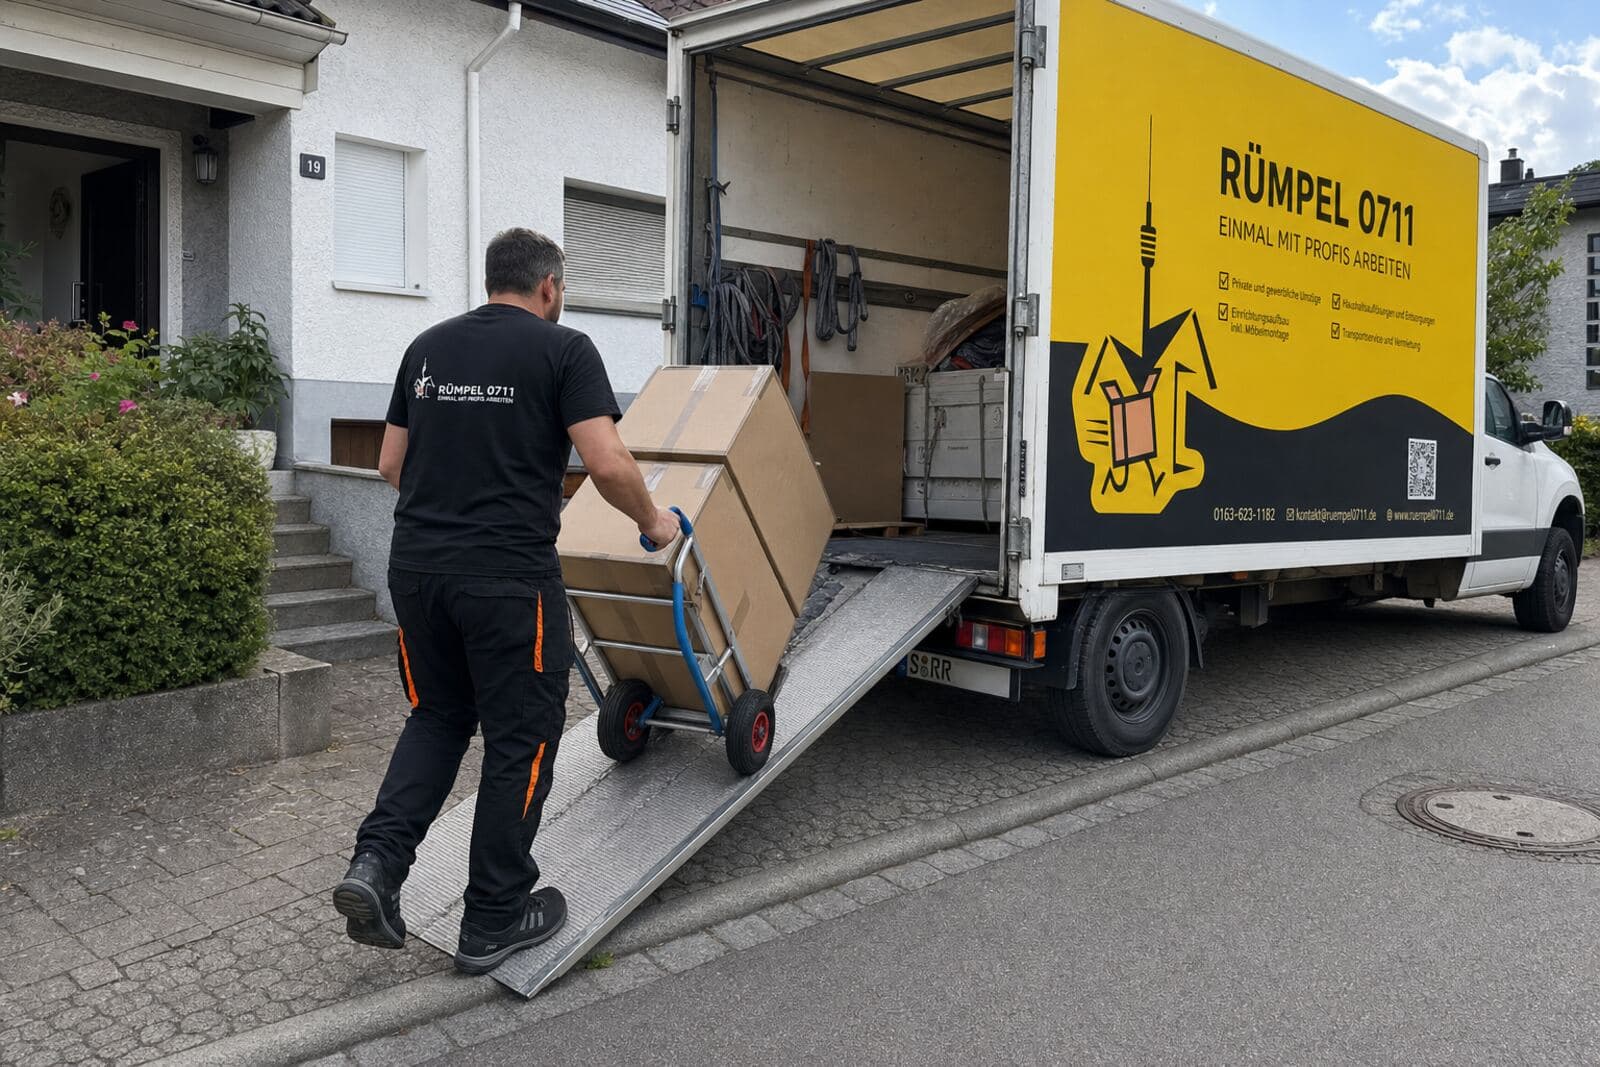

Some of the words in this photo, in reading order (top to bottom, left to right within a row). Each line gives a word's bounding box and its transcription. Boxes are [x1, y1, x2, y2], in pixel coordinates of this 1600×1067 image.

[307, 160, 320, 174] 19
[1220, 141, 1349, 228] RÜMPEL
[1358, 190, 1414, 246] 0711
[1219, 215, 1273, 247] EINMAL
[1278, 230, 1301, 253] MIT
[1305, 237, 1350, 266] PROFIS
[1353, 250, 1411, 280] ARBEITEN
[1231, 277, 1252, 291] Private
[1253, 284, 1265, 293] und
[1266, 285, 1299, 299] gewerbliche
[438, 382, 484, 395] RÜMPEL
[487, 385, 514, 397] 0711
[1213, 507, 1276, 521] 0163-623-1182
[910, 654, 919, 675] S
[930, 657, 951, 681] RR
